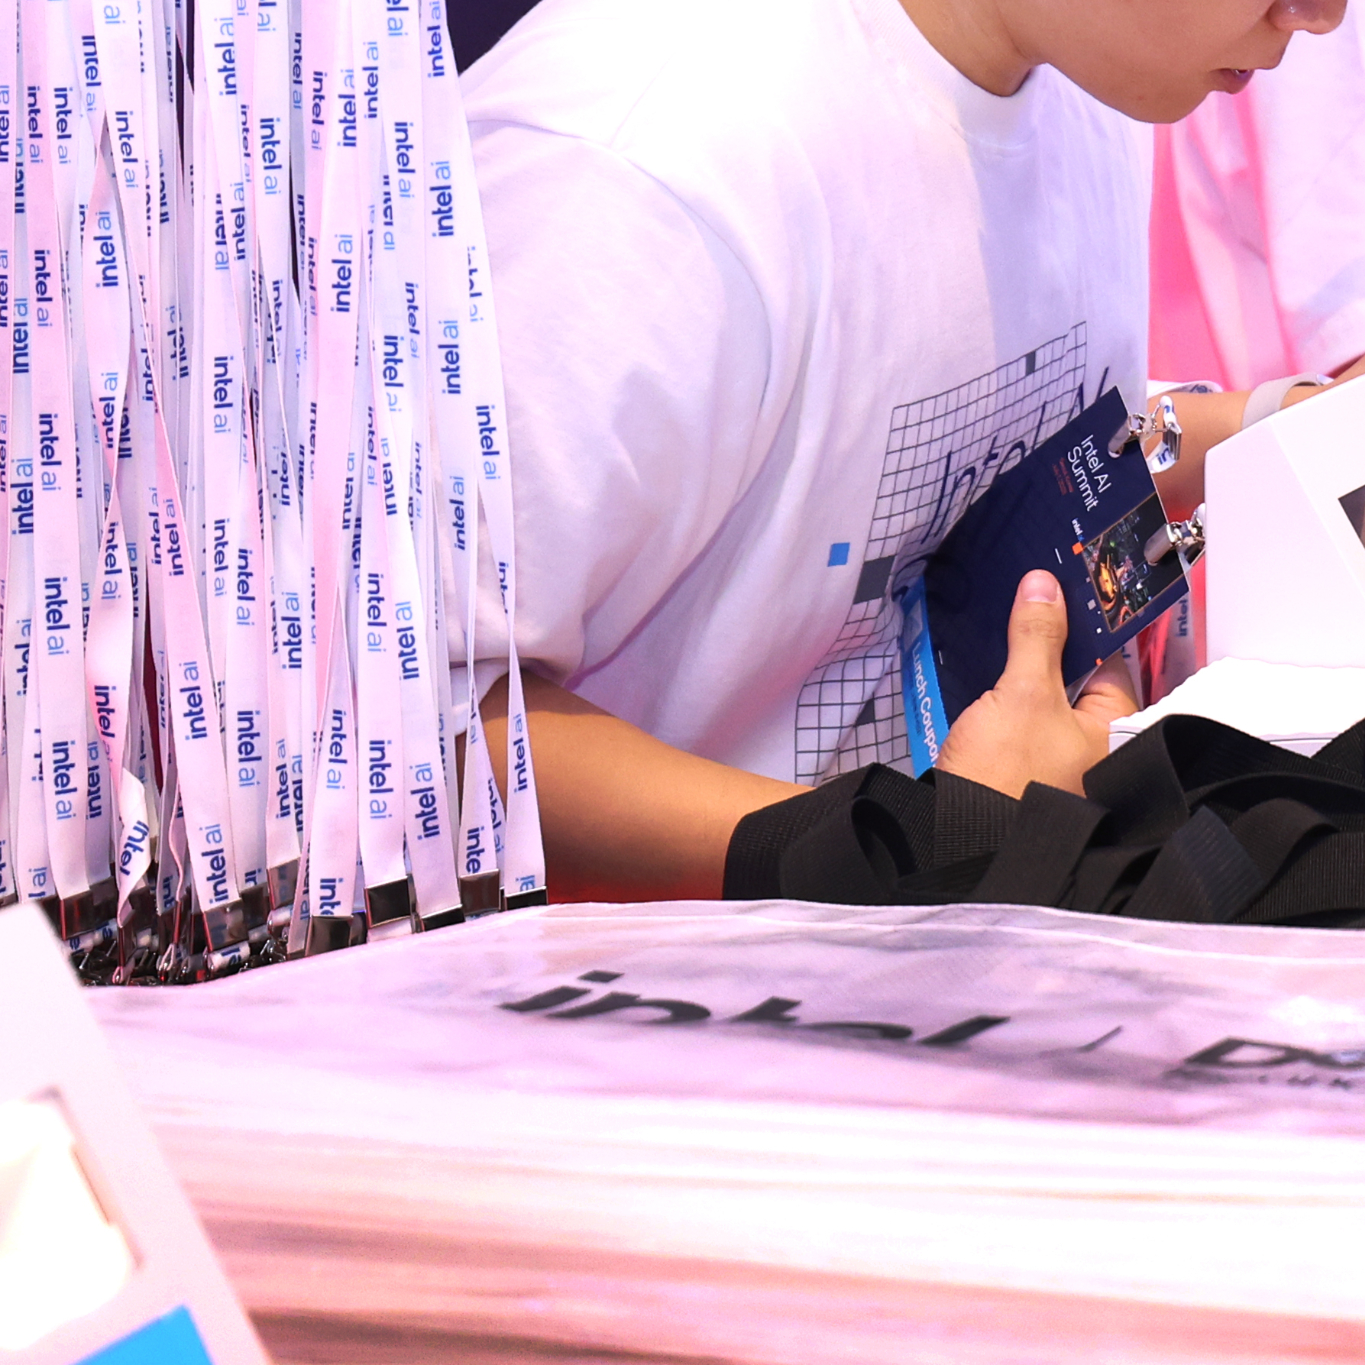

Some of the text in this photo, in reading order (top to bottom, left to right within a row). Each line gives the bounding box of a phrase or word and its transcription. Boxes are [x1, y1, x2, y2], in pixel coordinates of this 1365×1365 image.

[103, 5, 126, 24] ai
[258, 13, 276, 32] ai
[387, 17, 408, 36] ai
[427, 0, 445, 78] intel ai
[214, 42, 237, 96] intel
[312, 70, 327, 125] intel
[362, 42, 379, 119] intel ai
[27, 86, 43, 163] intel ai
[54, 87, 73, 164] intel ai
[115, 110, 138, 188] intel ai
[260, 117, 282, 195] intel ai
[337, 94, 357, 147] intel
[394, 122, 416, 198] intel ai
[231, 207, 245, 261] intel
[430, 161, 454, 237] intel ai
[93, 211, 119, 288] intel ai
[331, 234, 352, 313] intel ai
[34, 250, 53, 327] intel ai
[405, 282, 420, 335] intel
[214, 356, 234, 434] intel ai
[383, 335, 404, 387] intel
[438, 320, 461, 394] intel ai
[99, 372, 118, 449] intel ai
[476, 404, 501, 480] intel ai
[39, 414, 62, 491] intel ai
[1067, 446, 1099, 512] Summit
[1080, 434, 1104, 473] Intel
[1094, 474, 1112, 493] AI
[10, 483, 34, 535] intel
[163, 498, 184, 576] intel ai
[449, 475, 465, 551] intel ai
[101, 522, 122, 600] intel ai
[214, 519, 230, 596] intel ai
[236, 548, 256, 626] intel ai
[44, 577, 70, 656] intel ai
[281, 591, 302, 669] intel ai
[367, 573, 387, 652] intel ai
[395, 601, 420, 680] intel ai
[179, 661, 207, 740] intel ai
[912, 642, 928, 699] Lunch
[94, 685, 116, 738] intel
[237, 710, 262, 787] intel ai
[326, 709, 348, 790] intel ai
[52, 740, 78, 820] intel ai
[275, 739, 291, 819] intel ai
[369, 740, 394, 820] intel ai
[513, 713, 527, 793] intel ai
[409, 762, 440, 840] intel ai
[120, 820, 150, 876] intel
[200, 824, 229, 904] intel ai
[466, 826, 485, 874] inte
